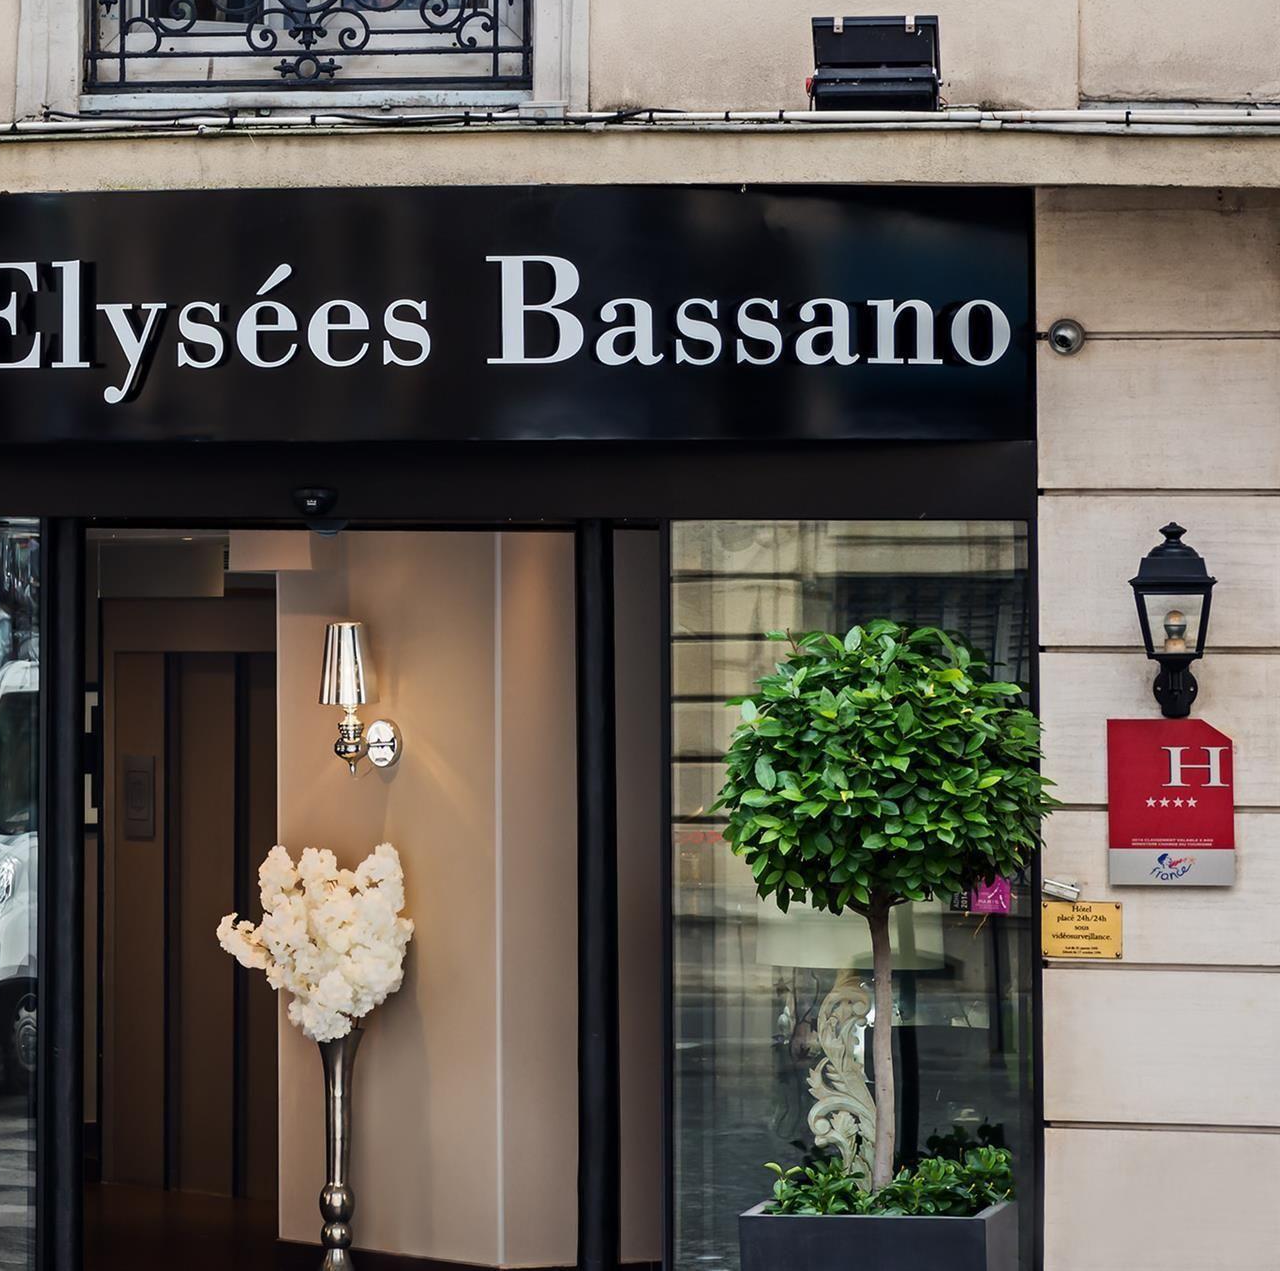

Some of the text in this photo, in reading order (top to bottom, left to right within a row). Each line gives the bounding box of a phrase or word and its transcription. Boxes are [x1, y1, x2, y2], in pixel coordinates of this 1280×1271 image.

[485, 255, 1011, 368] Bassano
[1160, 746, 1229, 787] H
[1072, 905, 1092, 913] Hôtel
